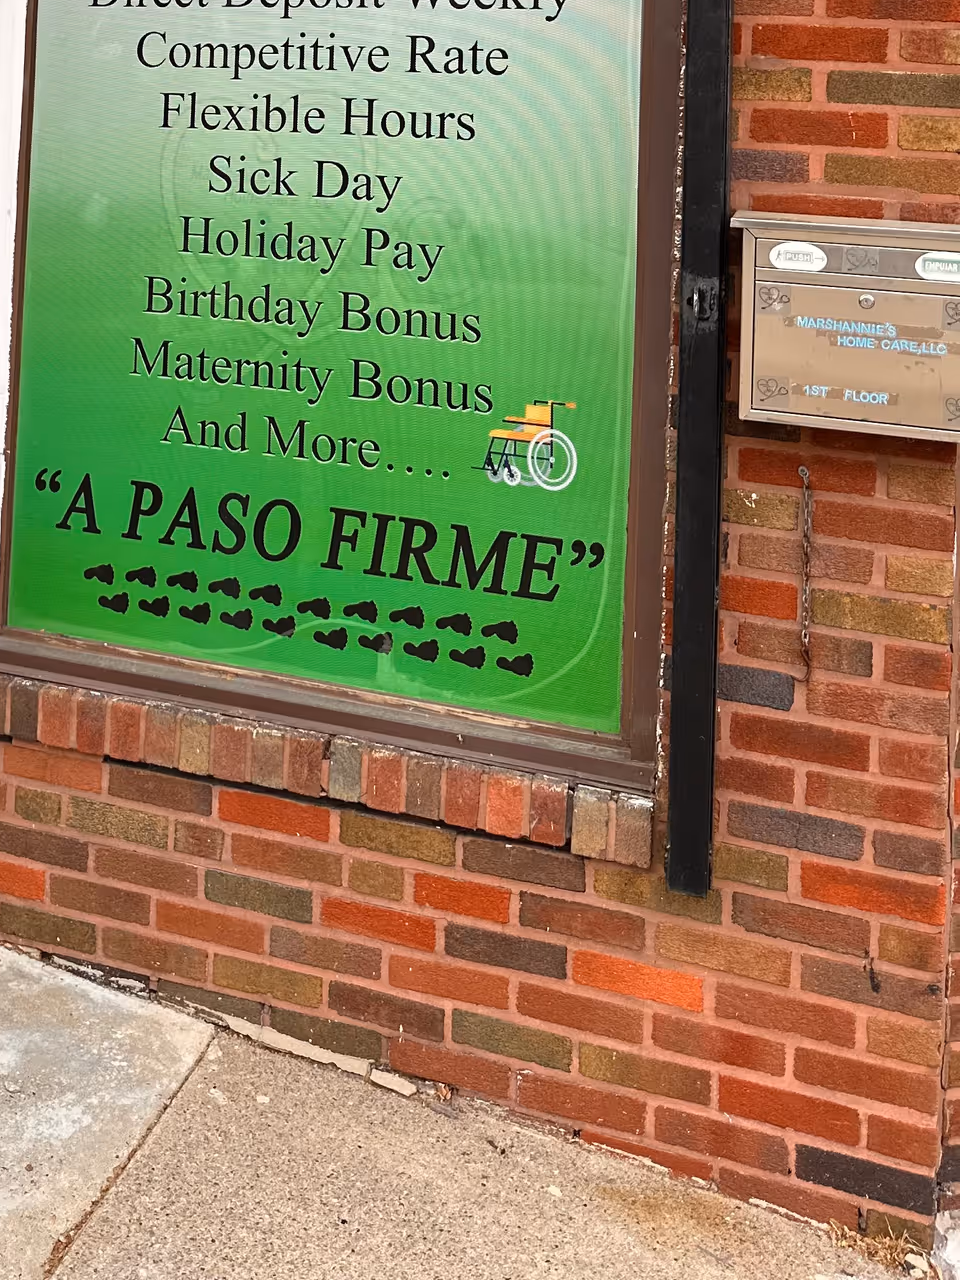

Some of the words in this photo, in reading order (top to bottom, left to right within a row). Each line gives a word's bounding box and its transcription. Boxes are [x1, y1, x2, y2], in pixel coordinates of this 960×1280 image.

[136, 31, 390, 79] Competitive
[405, 35, 510, 76] Rate
[159, 93, 326, 134] Flexible
[341, 97, 476, 141] Hours
[208, 155, 298, 197] Sick
[312, 160, 403, 213] Day
[178, 216, 346, 274] Holiday
[361, 227, 445, 282] Pay
[785, 252, 811, 262] PUSH
[143, 275, 324, 337] Birthday
[340, 291, 482, 345] Bonus
[797, 316, 897, 337] MARSHANNIE'S
[837, 336, 875, 349] HOME
[128, 337, 334, 405] Maternity
[349, 358, 495, 414] Bonus
[804, 384, 829, 397] 1ST
[844, 389, 889, 404] FLOOR
[161, 405, 249, 453] And
[121, 480, 302, 562] PASO
